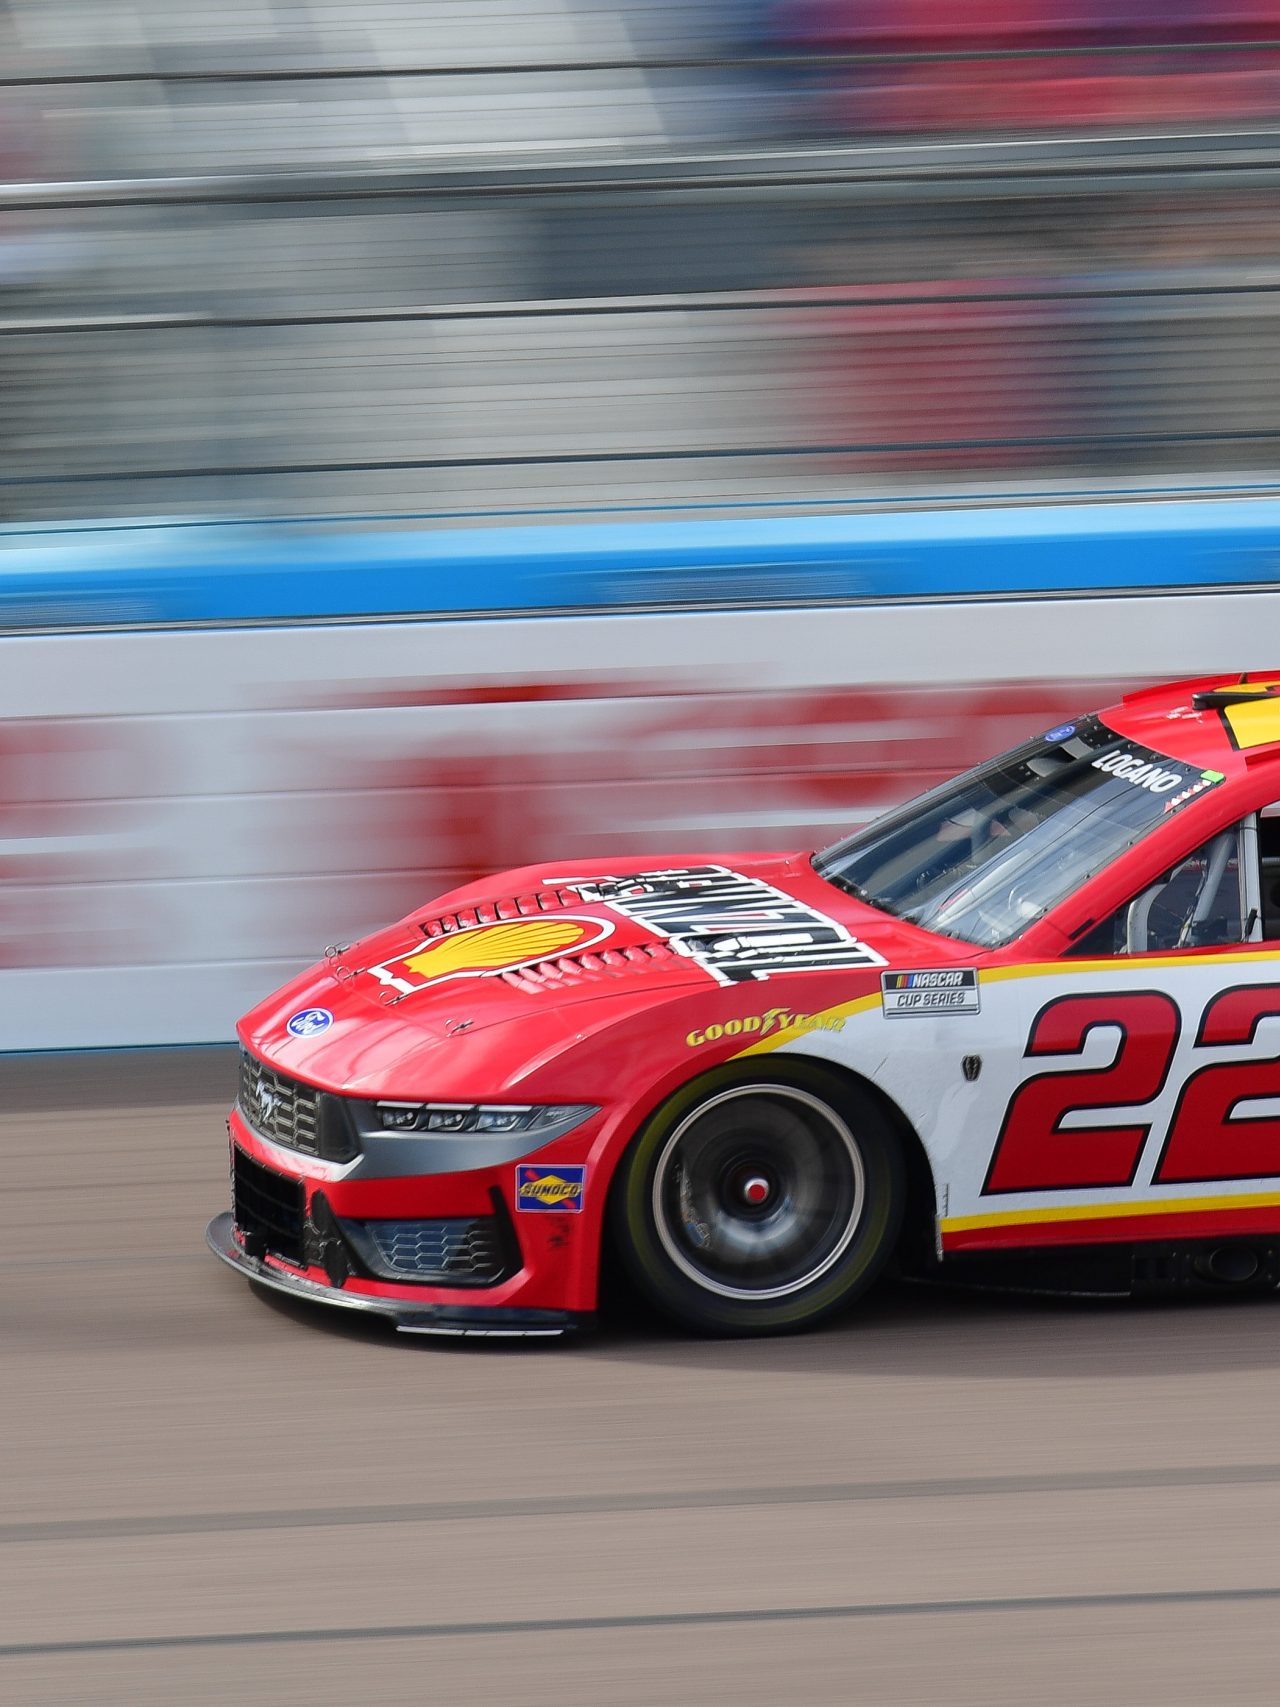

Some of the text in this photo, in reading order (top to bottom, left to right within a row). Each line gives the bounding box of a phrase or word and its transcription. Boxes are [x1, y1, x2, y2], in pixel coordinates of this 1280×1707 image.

[1091, 749, 1183, 793] LOGANO
[912, 971, 964, 988] NASCAR
[896, 991, 966, 1007] CUP SERIES
[686, 1007, 847, 1047] GOODYEAR
[524, 1182, 580, 1196] SUNOCO
